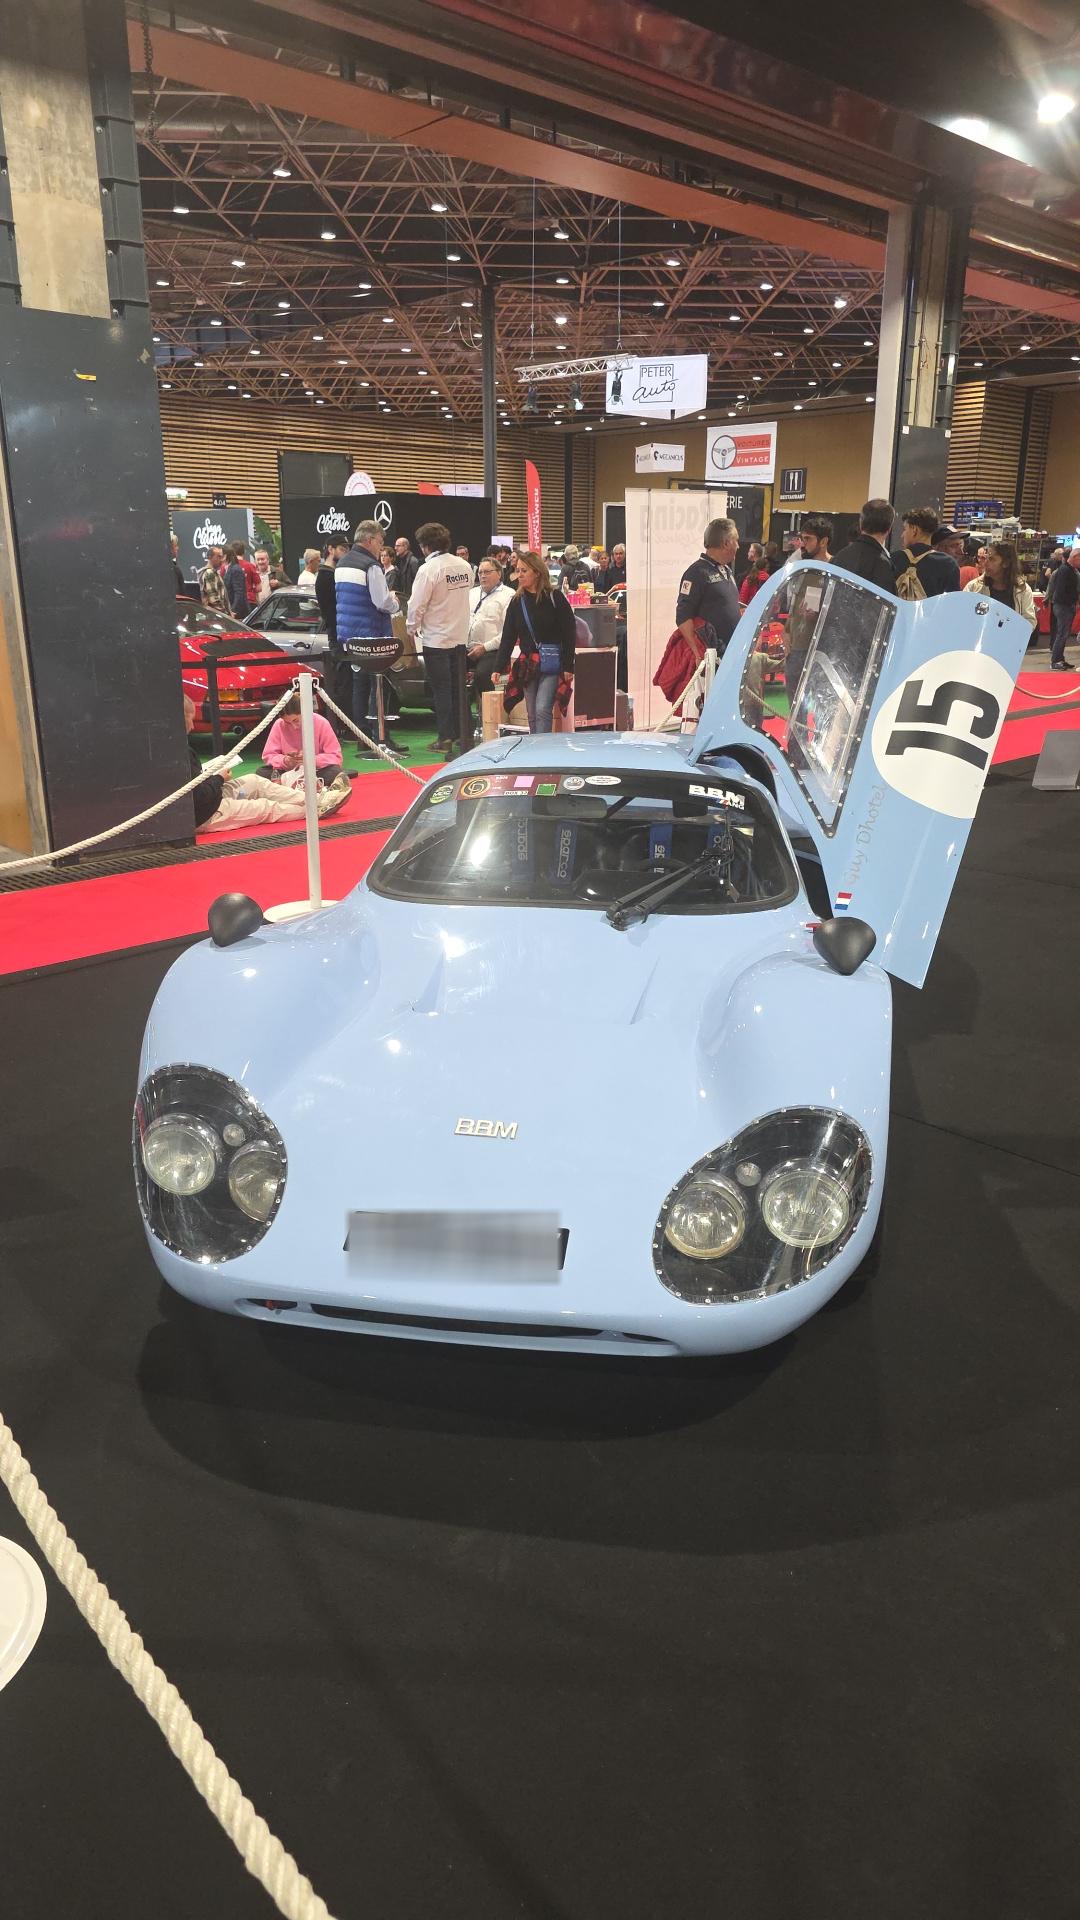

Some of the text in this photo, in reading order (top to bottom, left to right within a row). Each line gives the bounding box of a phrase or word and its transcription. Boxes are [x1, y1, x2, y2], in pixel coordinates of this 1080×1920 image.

[641, 366, 672, 377] PETER
[632, 379, 679, 401] auto
[736, 456, 769, 464] VINTAGE
[446, 573, 469, 584] Racing
[349, 643, 399, 653] RACING LEGEND
[885, 679, 1000, 771] 15
[689, 784, 745, 806] BBM
[557, 828, 572, 878] sparco
[454, 1118, 518, 1140] BBM
